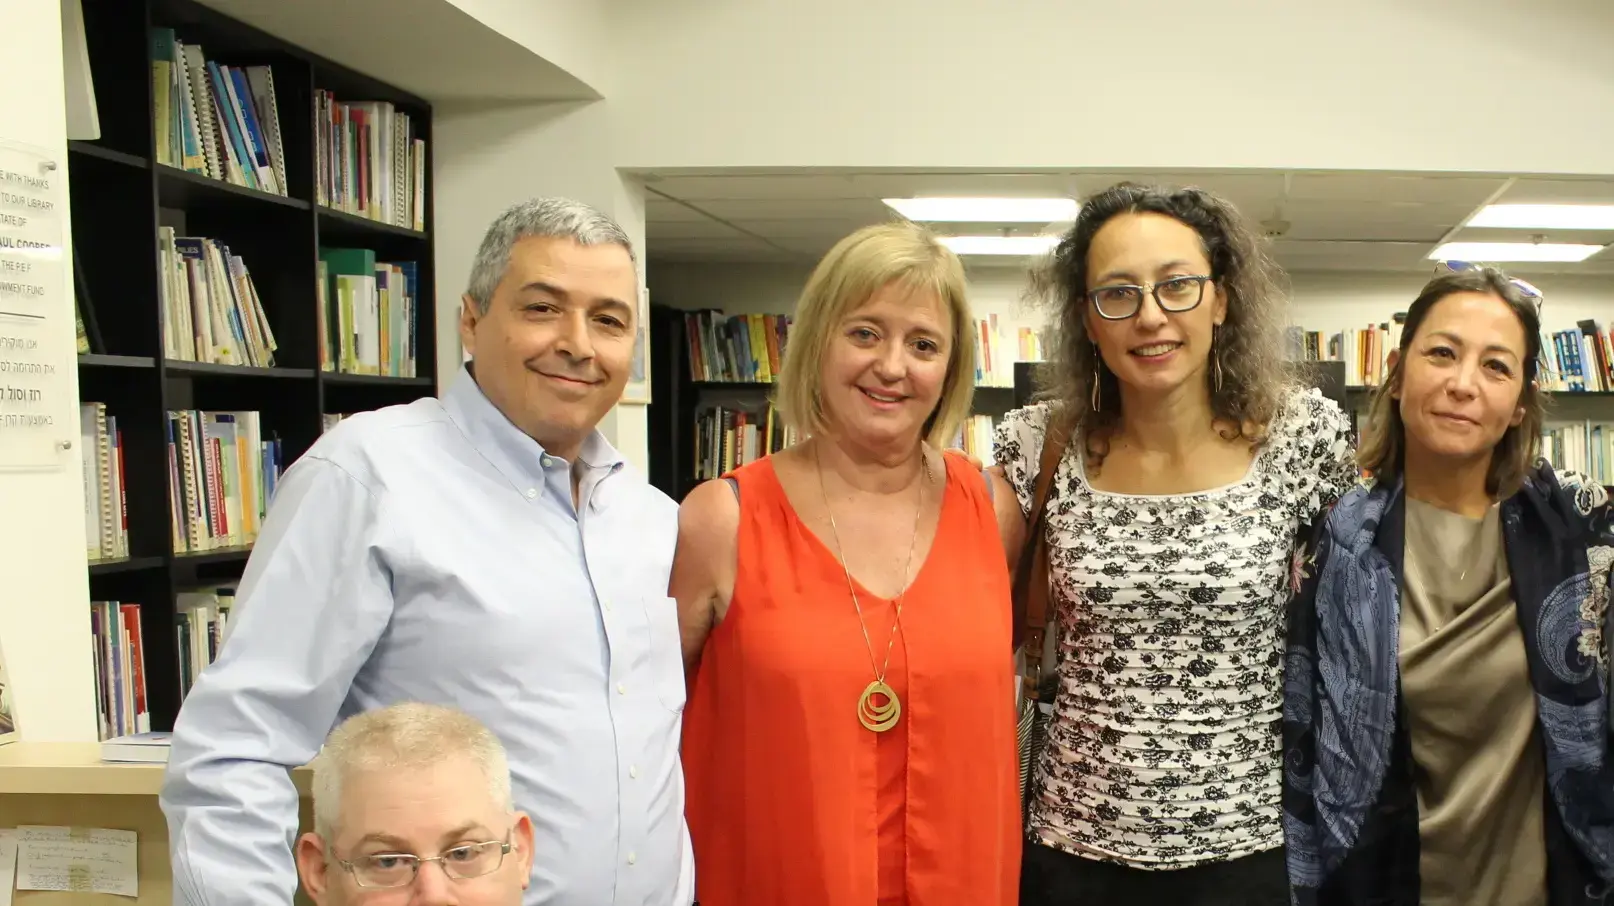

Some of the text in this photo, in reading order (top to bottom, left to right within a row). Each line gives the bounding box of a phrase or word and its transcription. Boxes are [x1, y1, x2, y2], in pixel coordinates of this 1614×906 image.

[5, 172, 22, 184] WITH
[23, 175, 49, 190] THANKS
[1, 191, 55, 211] TO OUR LIBRARY
[18, 216, 28, 227] OF
[1, 260, 15, 271] THE
[13, 362, 42, 375] התרומה
[7, 384, 27, 401] וסול
[29, 389, 42, 401] רוז
